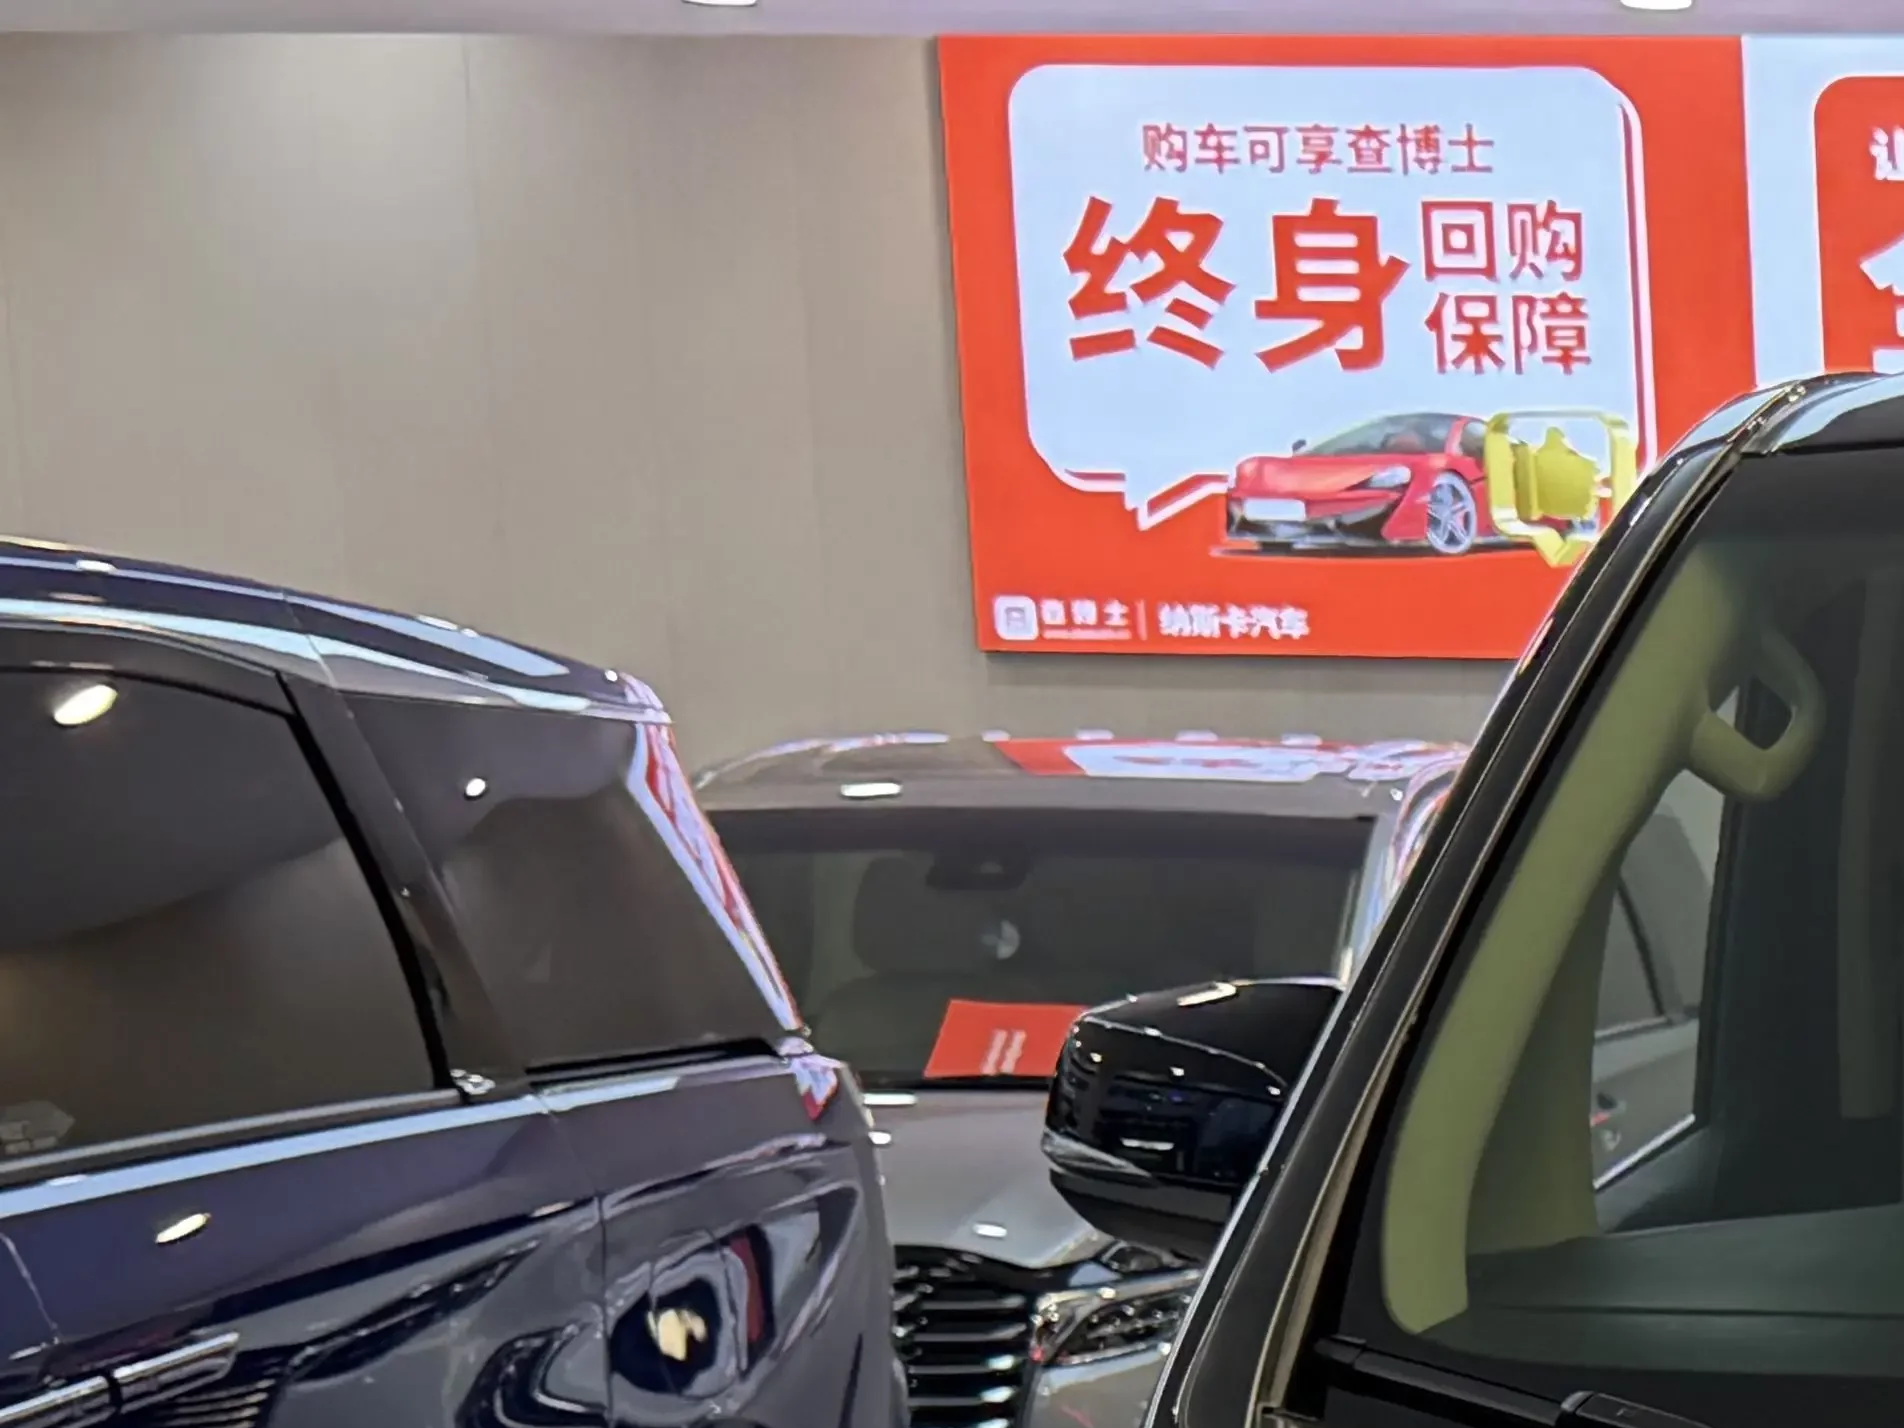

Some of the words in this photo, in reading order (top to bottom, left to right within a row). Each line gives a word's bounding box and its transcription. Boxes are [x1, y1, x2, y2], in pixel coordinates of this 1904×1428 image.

[1141, 122, 1495, 175] 购车可享查博士
[1422, 200, 1584, 283] 回购
[1063, 197, 1410, 372] 终身
[1425, 292, 1592, 375] 保障
